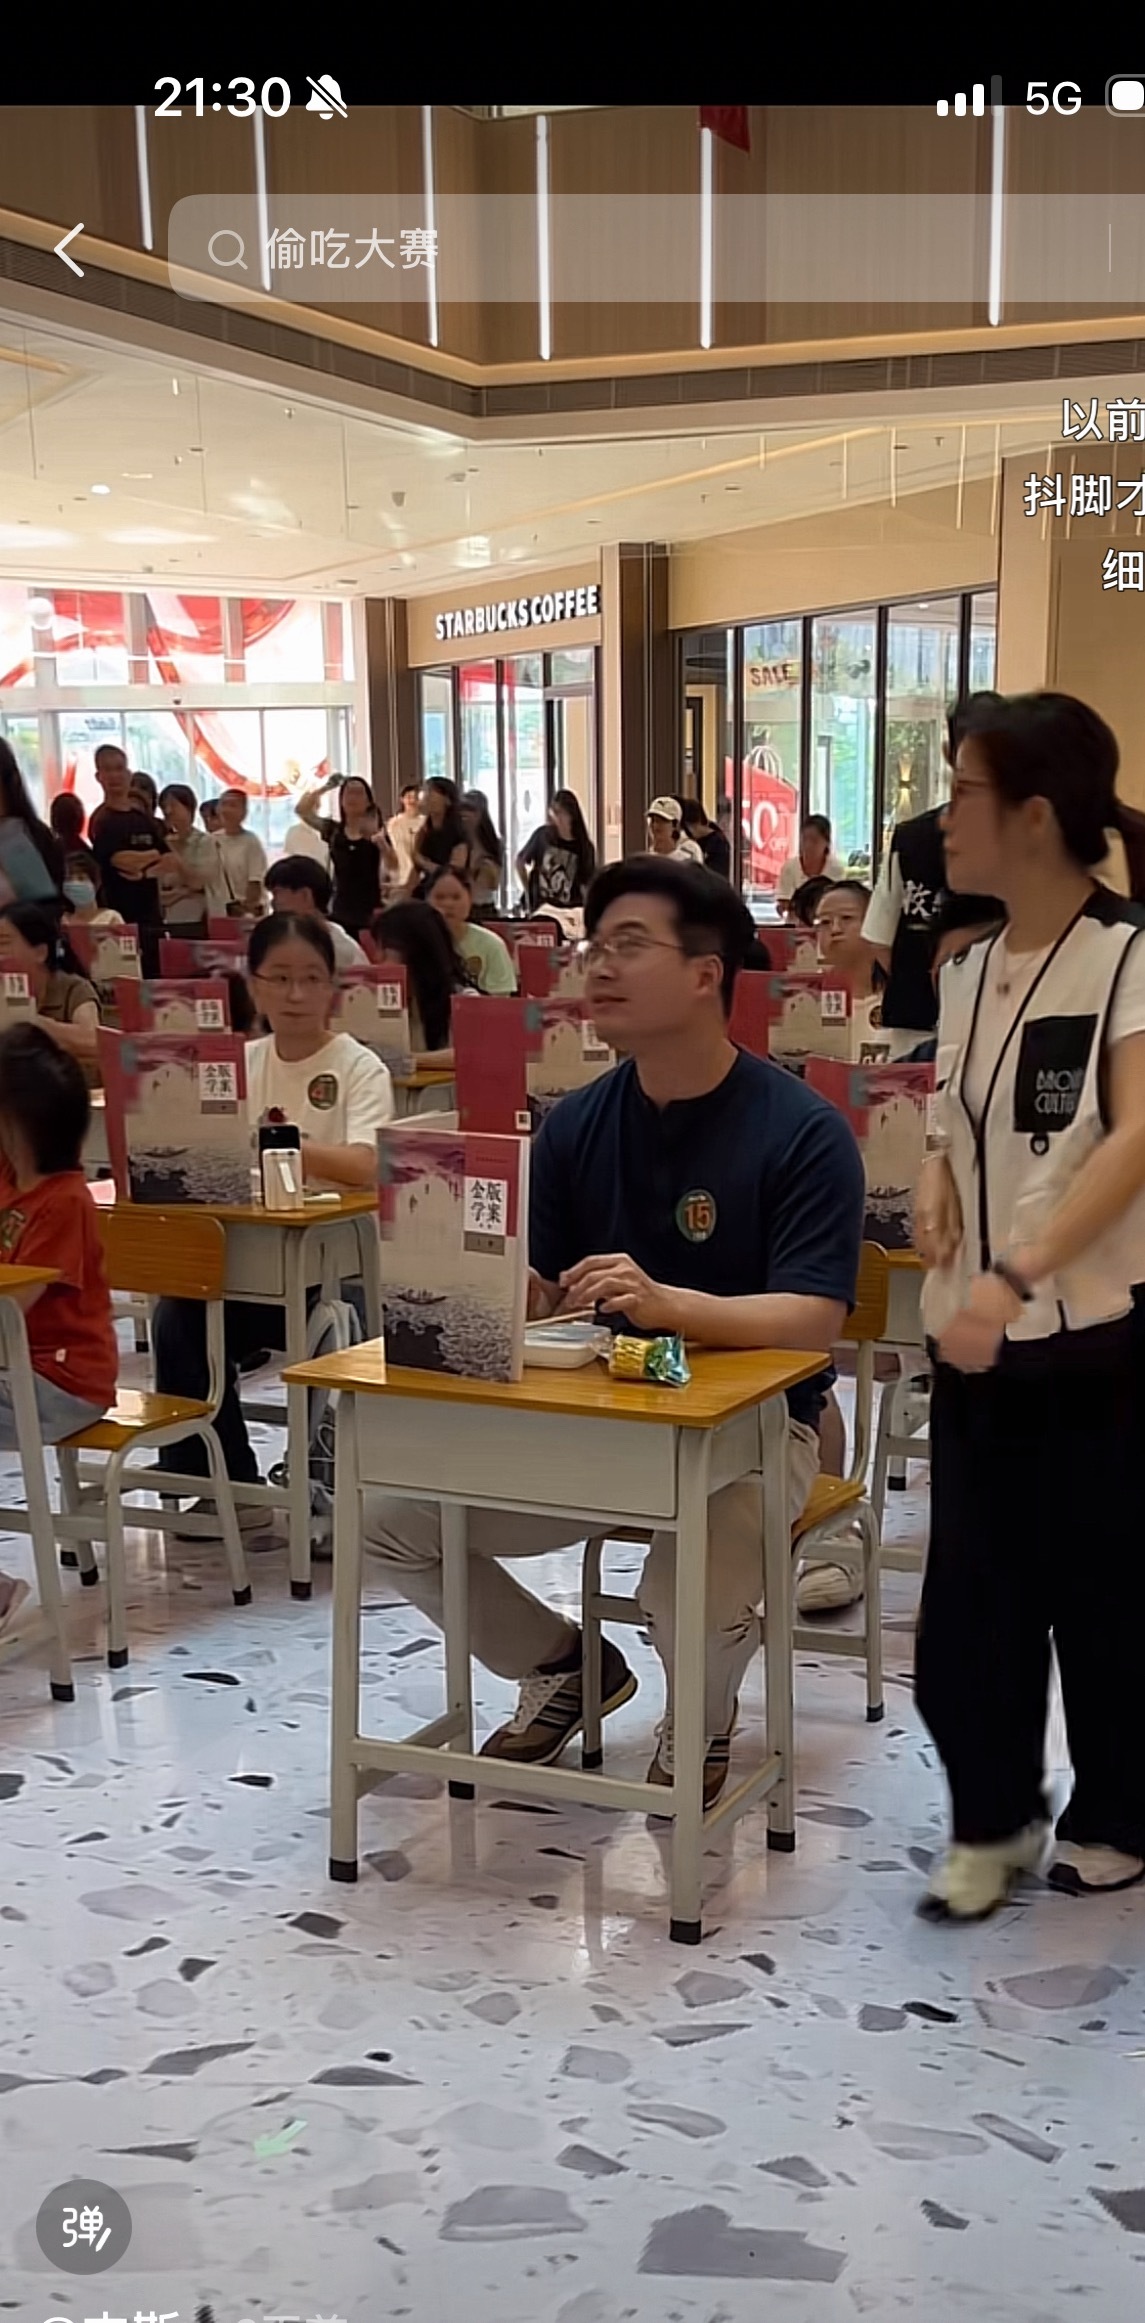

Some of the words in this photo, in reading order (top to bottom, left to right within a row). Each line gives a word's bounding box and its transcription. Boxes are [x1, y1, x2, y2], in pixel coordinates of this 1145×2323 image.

[435, 598, 528, 640] STARBUCKS
[531, 584, 598, 624] COFFEE
[470, 1179, 502, 1203] 金版
[685, 1203, 710, 1230] 15
